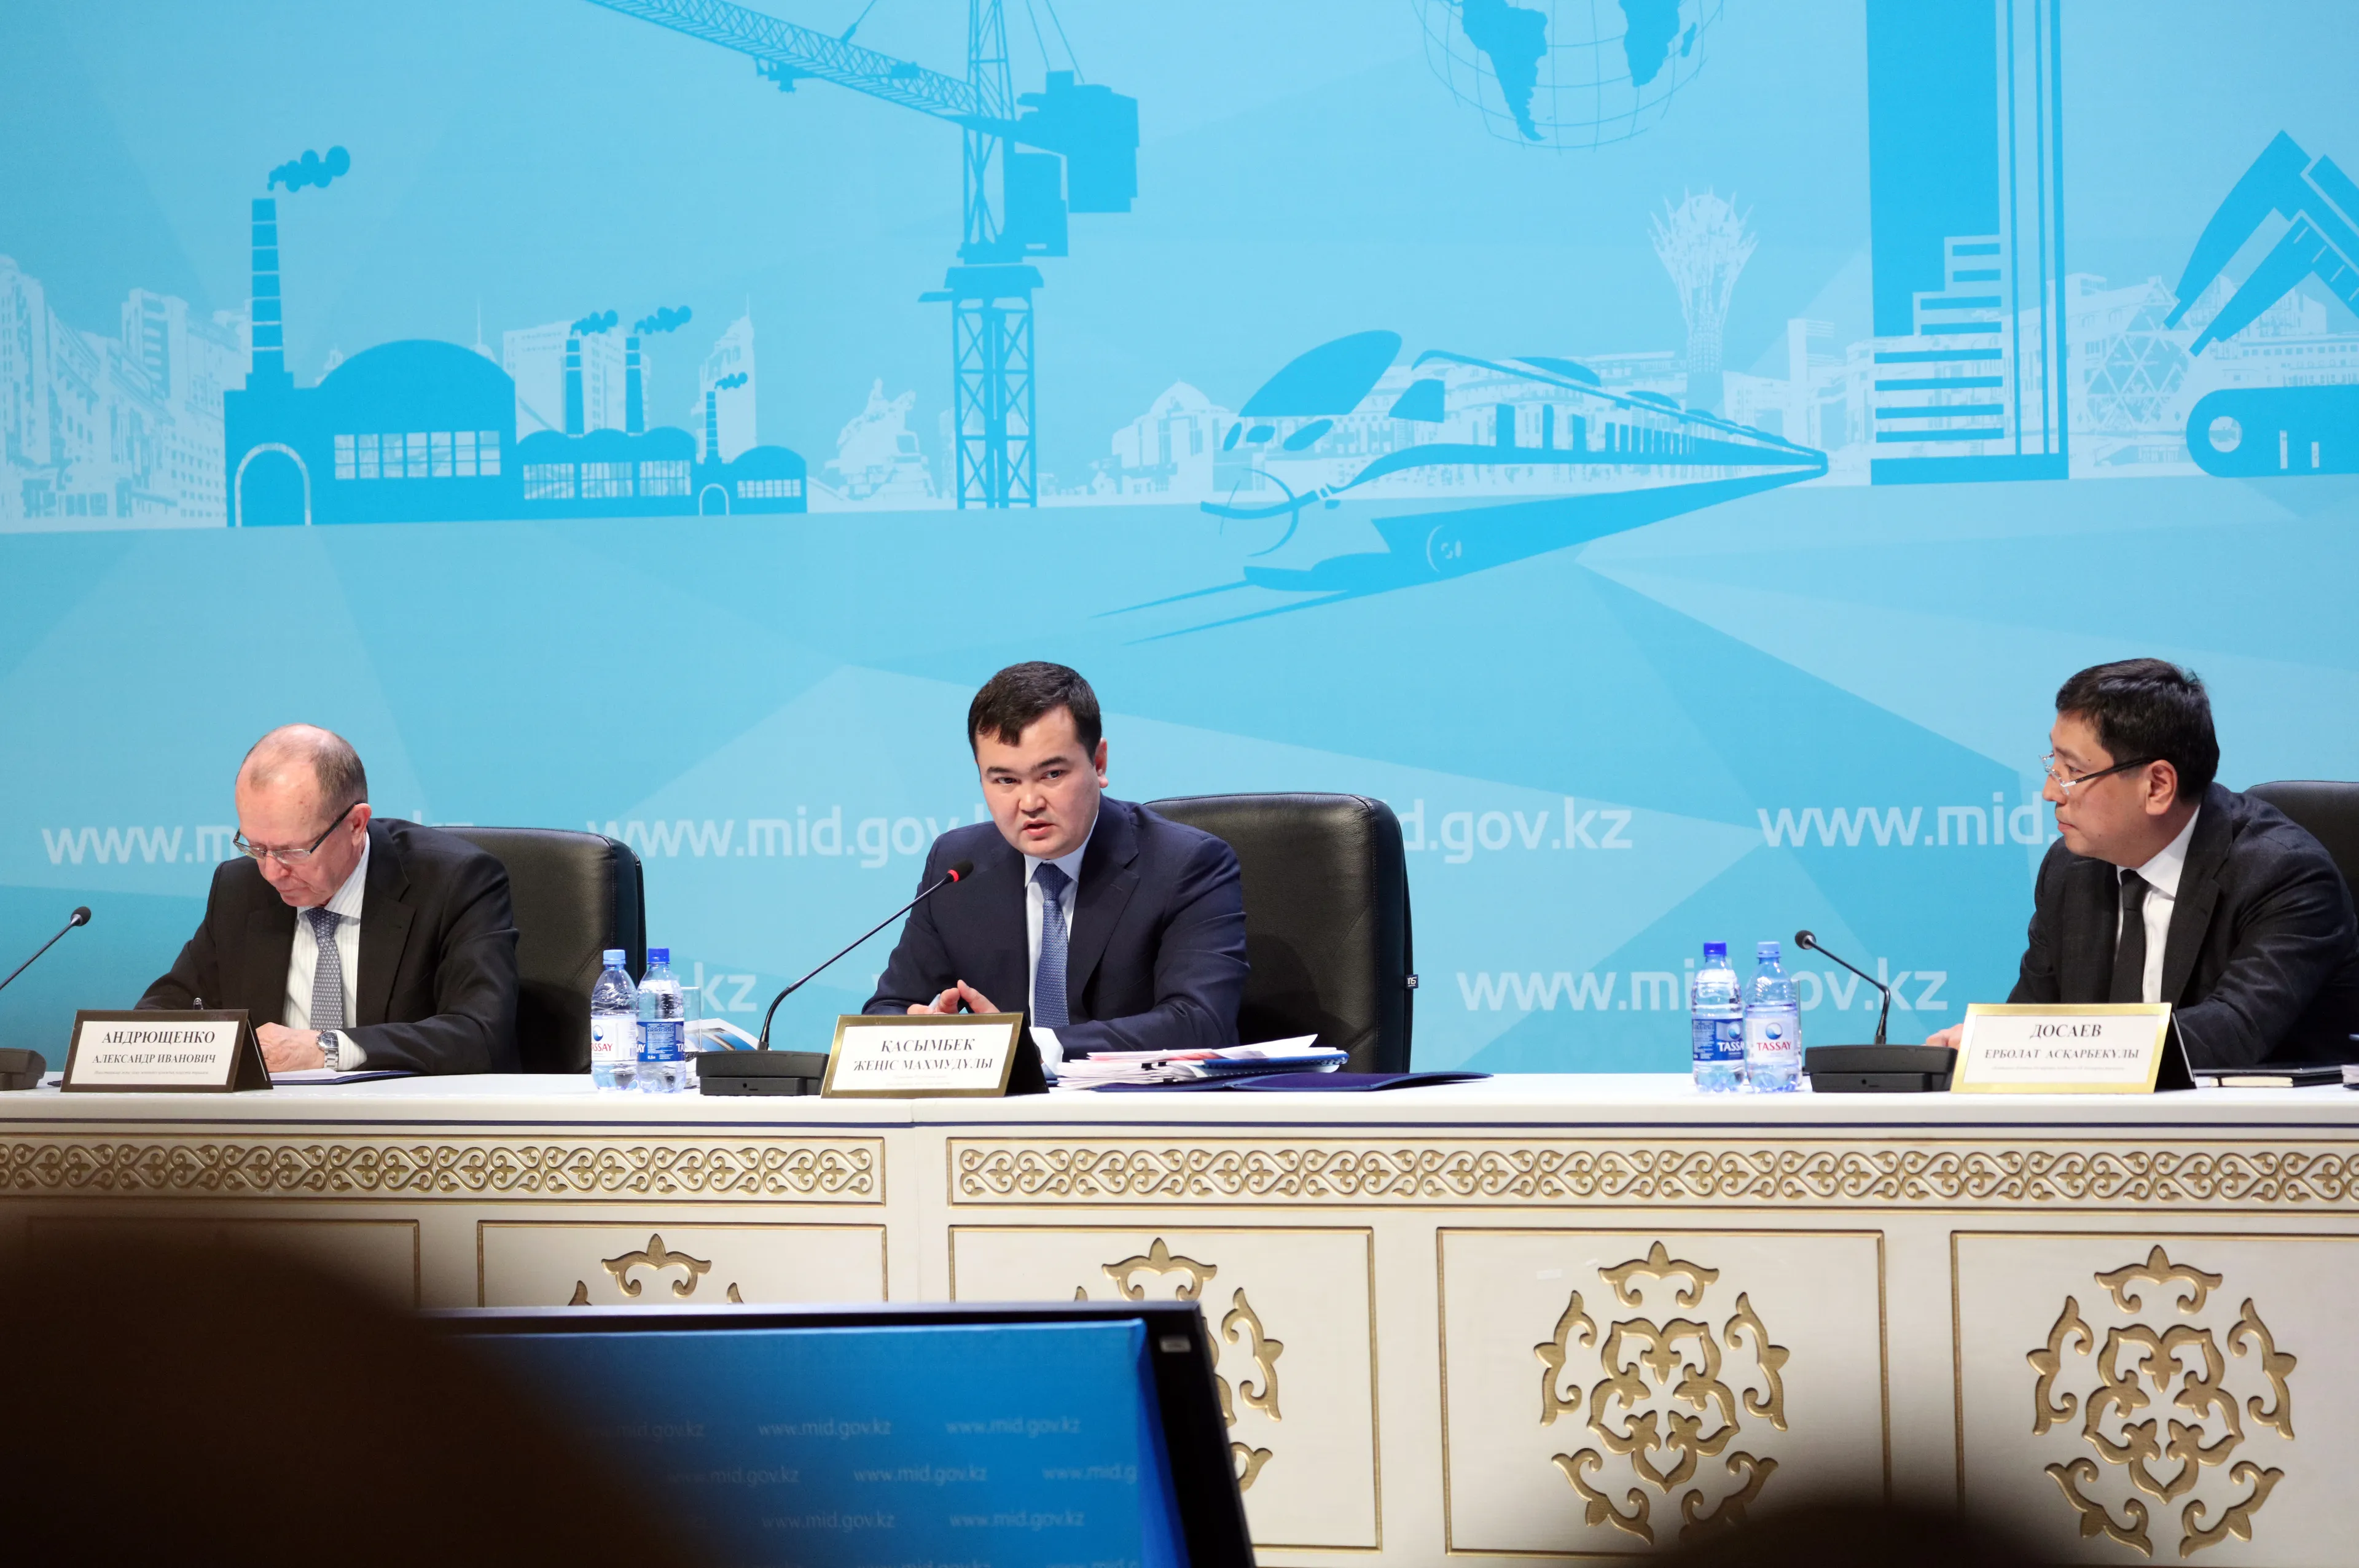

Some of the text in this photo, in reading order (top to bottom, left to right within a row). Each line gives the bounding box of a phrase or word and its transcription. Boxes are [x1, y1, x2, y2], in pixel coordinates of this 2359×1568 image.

[1756, 790, 2057, 847] www.mid.
[587, 803, 985, 868] www.mid.gov
[1397, 797, 1633, 864] d.gov.kz
[1457, 958, 1948, 1011] www.miov.kz
[101, 1031, 215, 1045] АНДРЮЩЕНКО
[2029, 1024, 2102, 1039] ДОСАЕВ
[592, 1043, 613, 1051] ASSAY
[881, 1039, 976, 1053] ҚАСЫМБЕК
[1717, 1041, 1745, 1051] TASSA
[1757, 1042, 1791, 1051] TASSAY
[1985, 1049, 2041, 1059] ЕРБОЛАТ
[92, 1054, 216, 1064] АЛЕКСАНДР ИВАНОВИЧ
[758, 1417, 892, 1440] www.mid.gov.kz
[946, 1416, 1081, 1438] www.mid.gov.kz
[853, 1464, 988, 1486] www.mid.gov.kz
[1042, 1463, 1136, 1484] www.mid.g
[761, 1510, 895, 1533] www.mid.gov.kz
[949, 1508, 1084, 1531] www.mid.gov.kz
